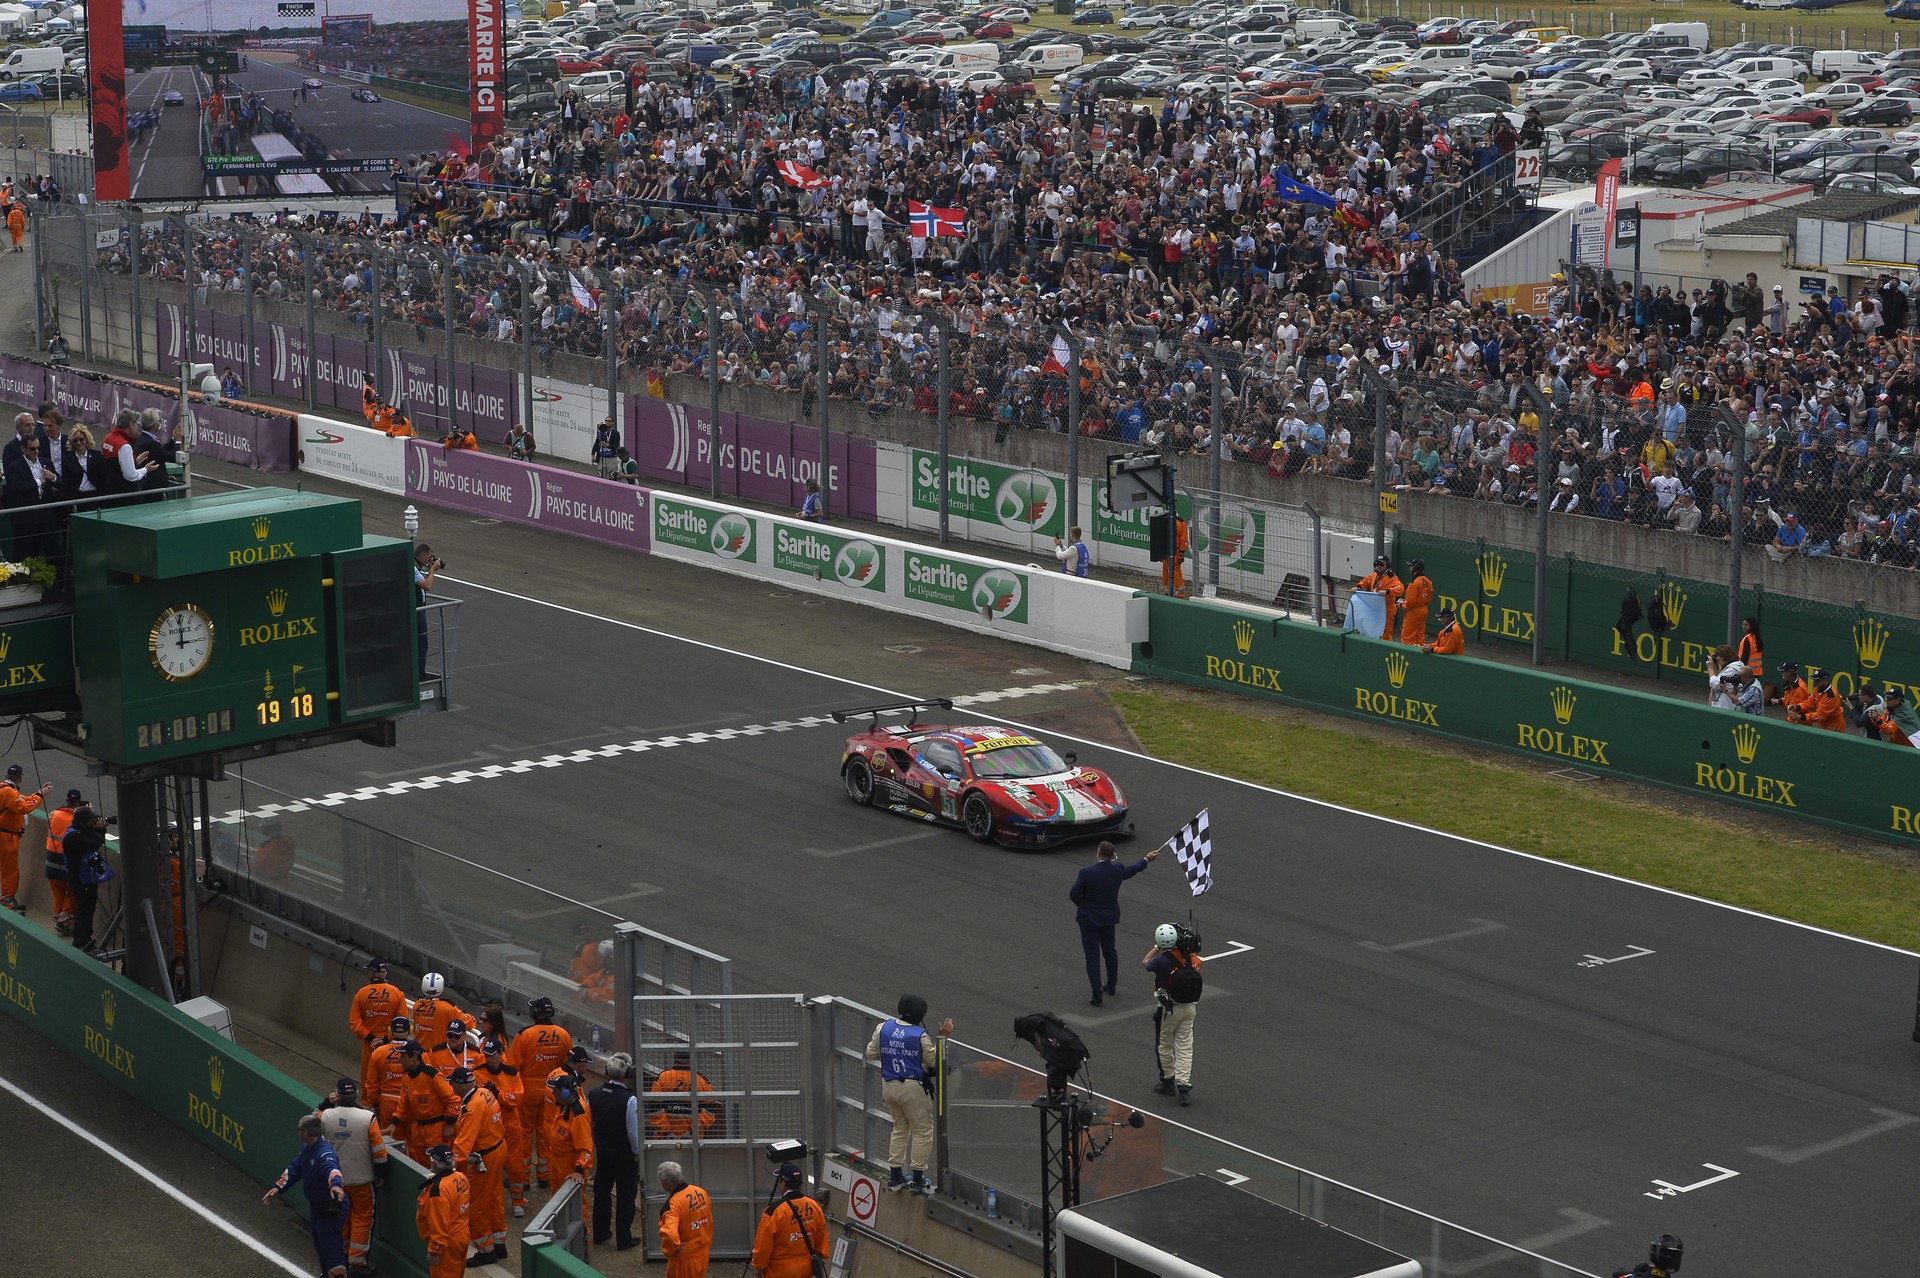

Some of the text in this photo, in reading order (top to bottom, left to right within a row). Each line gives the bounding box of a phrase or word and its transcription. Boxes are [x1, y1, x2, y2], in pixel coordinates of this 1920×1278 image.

[477, 80, 495, 112] ICI
[1517, 156, 1538, 178] 22
[1620, 222, 1625, 231] P
[1535, 293, 1546, 304] 22
[209, 338, 219, 356] DE
[222, 340, 232, 360] LA
[291, 353, 309, 376] PAY
[317, 360, 329, 382] DE
[331, 364, 344, 385] LA
[408, 362, 426, 376] Région
[409, 379, 434, 404] PAYS
[455, 390, 470, 412] LA
[471, 393, 504, 420] LOIRE
[200, 427, 214, 442] PAYS
[216, 431, 224, 445] DE
[433, 457, 447, 468] Région
[741, 448, 761, 475] DE
[767, 452, 786, 480] LA
[433, 470, 512, 503] PAYS DE LA LOIRE
[547, 482, 562, 493] Région
[918, 490, 928, 501] Le
[546, 496, 634, 531] PAYS DE LA LOIRE
[658, 503, 707, 535] Sarthe
[658, 528, 697, 545] Le Département
[1098, 524, 1107, 533] Le
[229, 542, 295, 566] ROLEX
[778, 529, 831, 562] Sarthe
[778, 554, 784, 563] Le
[909, 557, 968, 591] Sarthe
[909, 583, 954, 601] Le Département
[169, 626, 192, 636] ROLEX
[240, 617, 317, 647] ROLEX
[1206, 655, 1283, 692] ROLEX
[258, 700, 280, 725] 19
[291, 694, 313, 718] 18
[1355, 688, 1439, 727] ROLEX
[1517, 724, 1610, 766] ROLEX
[1696, 762, 1796, 807] ROLEX
[84, 1025, 135, 1079] ROLEX
[892, 1059, 906, 1073] 61
[188, 1093, 244, 1152] ROLEX
[831, 1170, 842, 1181] DC1
